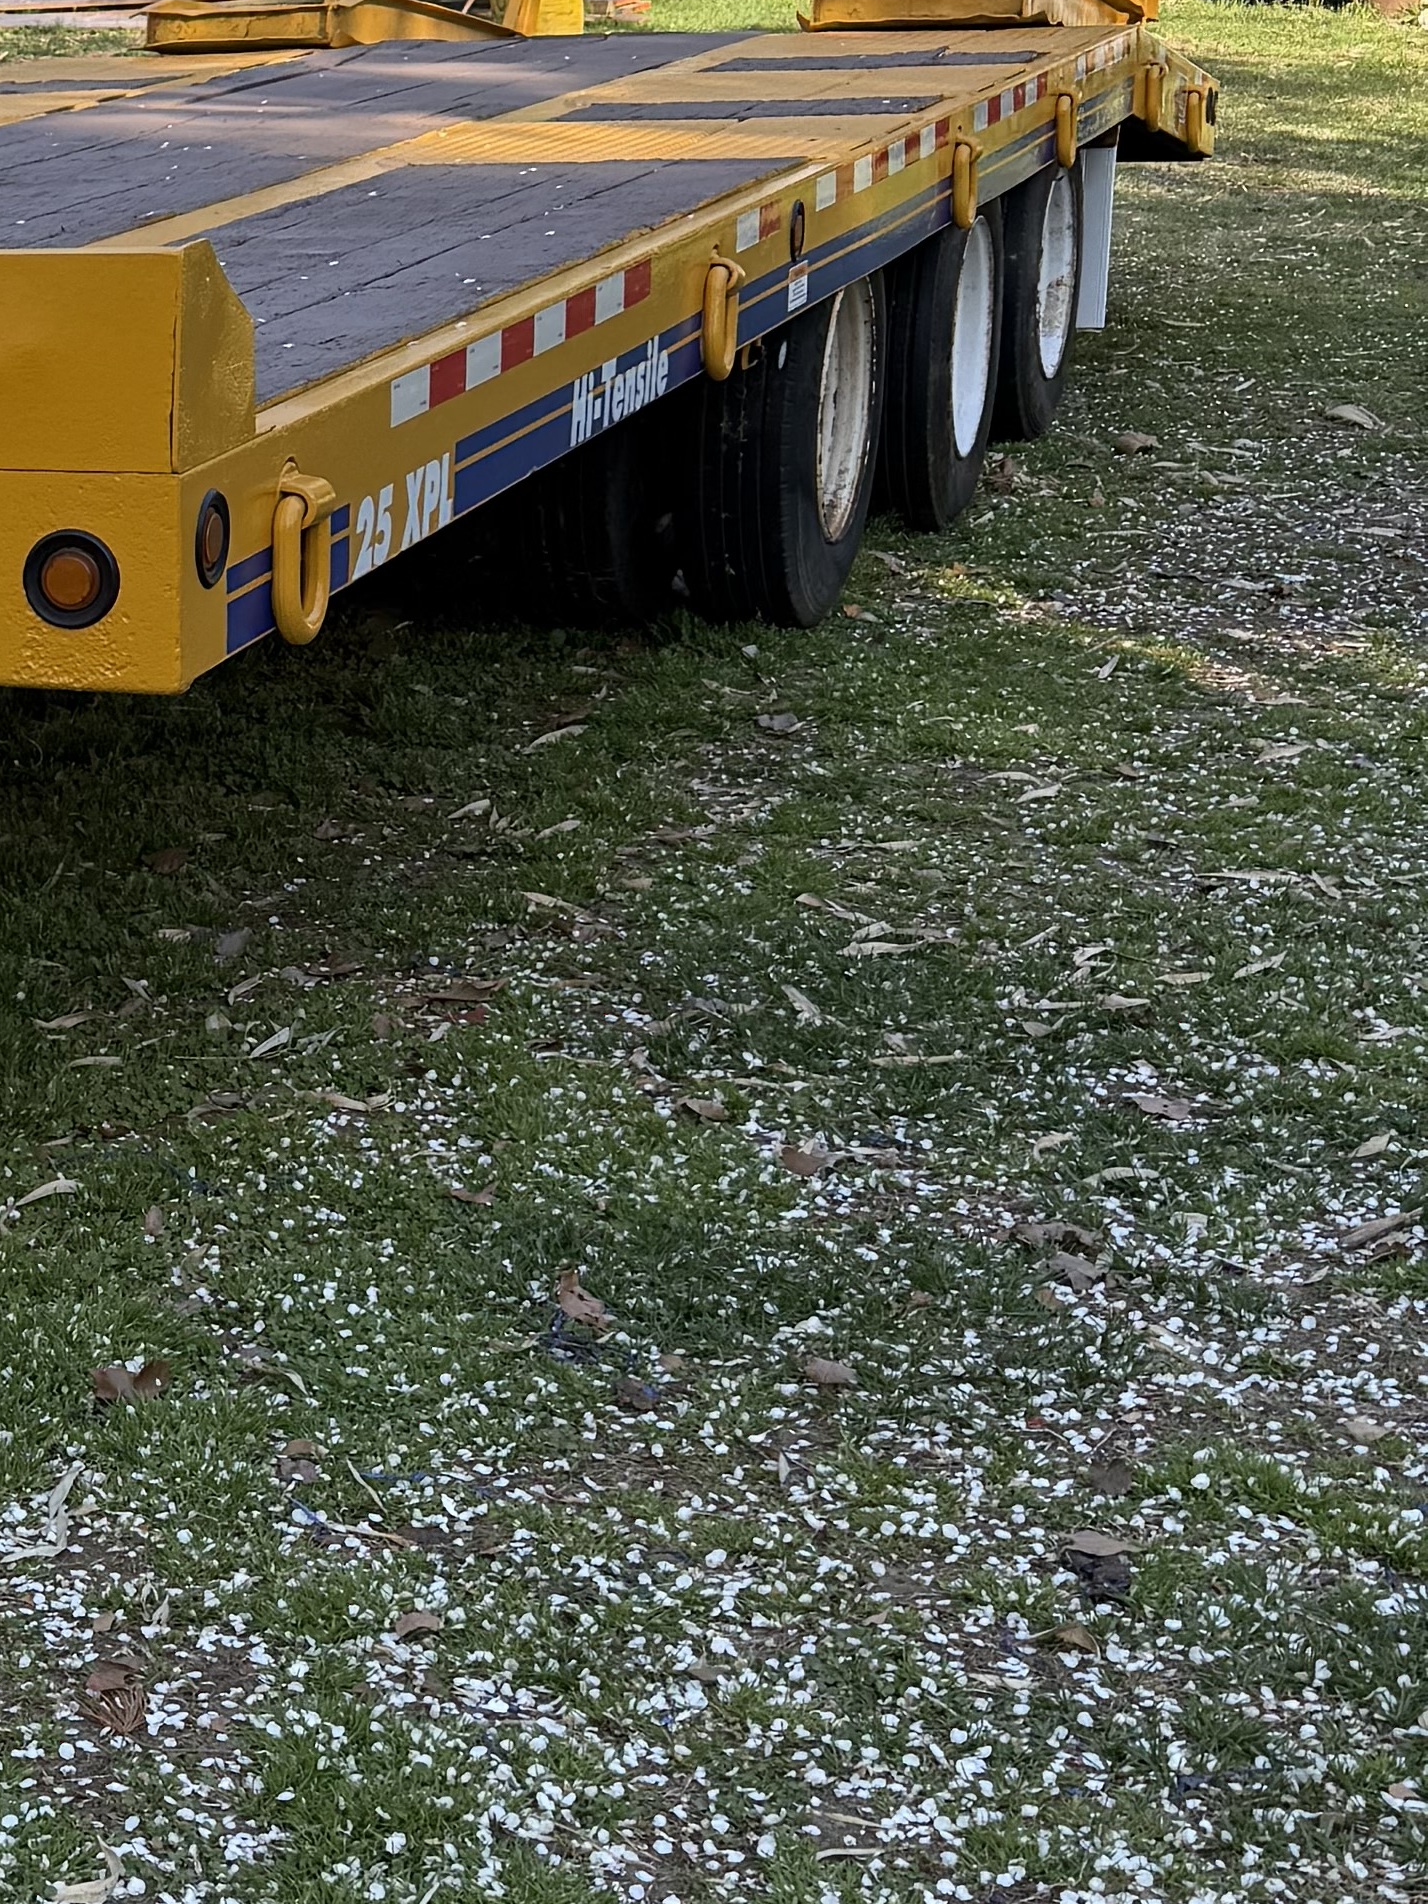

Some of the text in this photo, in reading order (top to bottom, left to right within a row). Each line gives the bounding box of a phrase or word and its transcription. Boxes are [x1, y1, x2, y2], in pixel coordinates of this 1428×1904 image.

[570, 335, 669, 448] Hi-Tensile
[351, 452, 453, 582] 25 XPL
